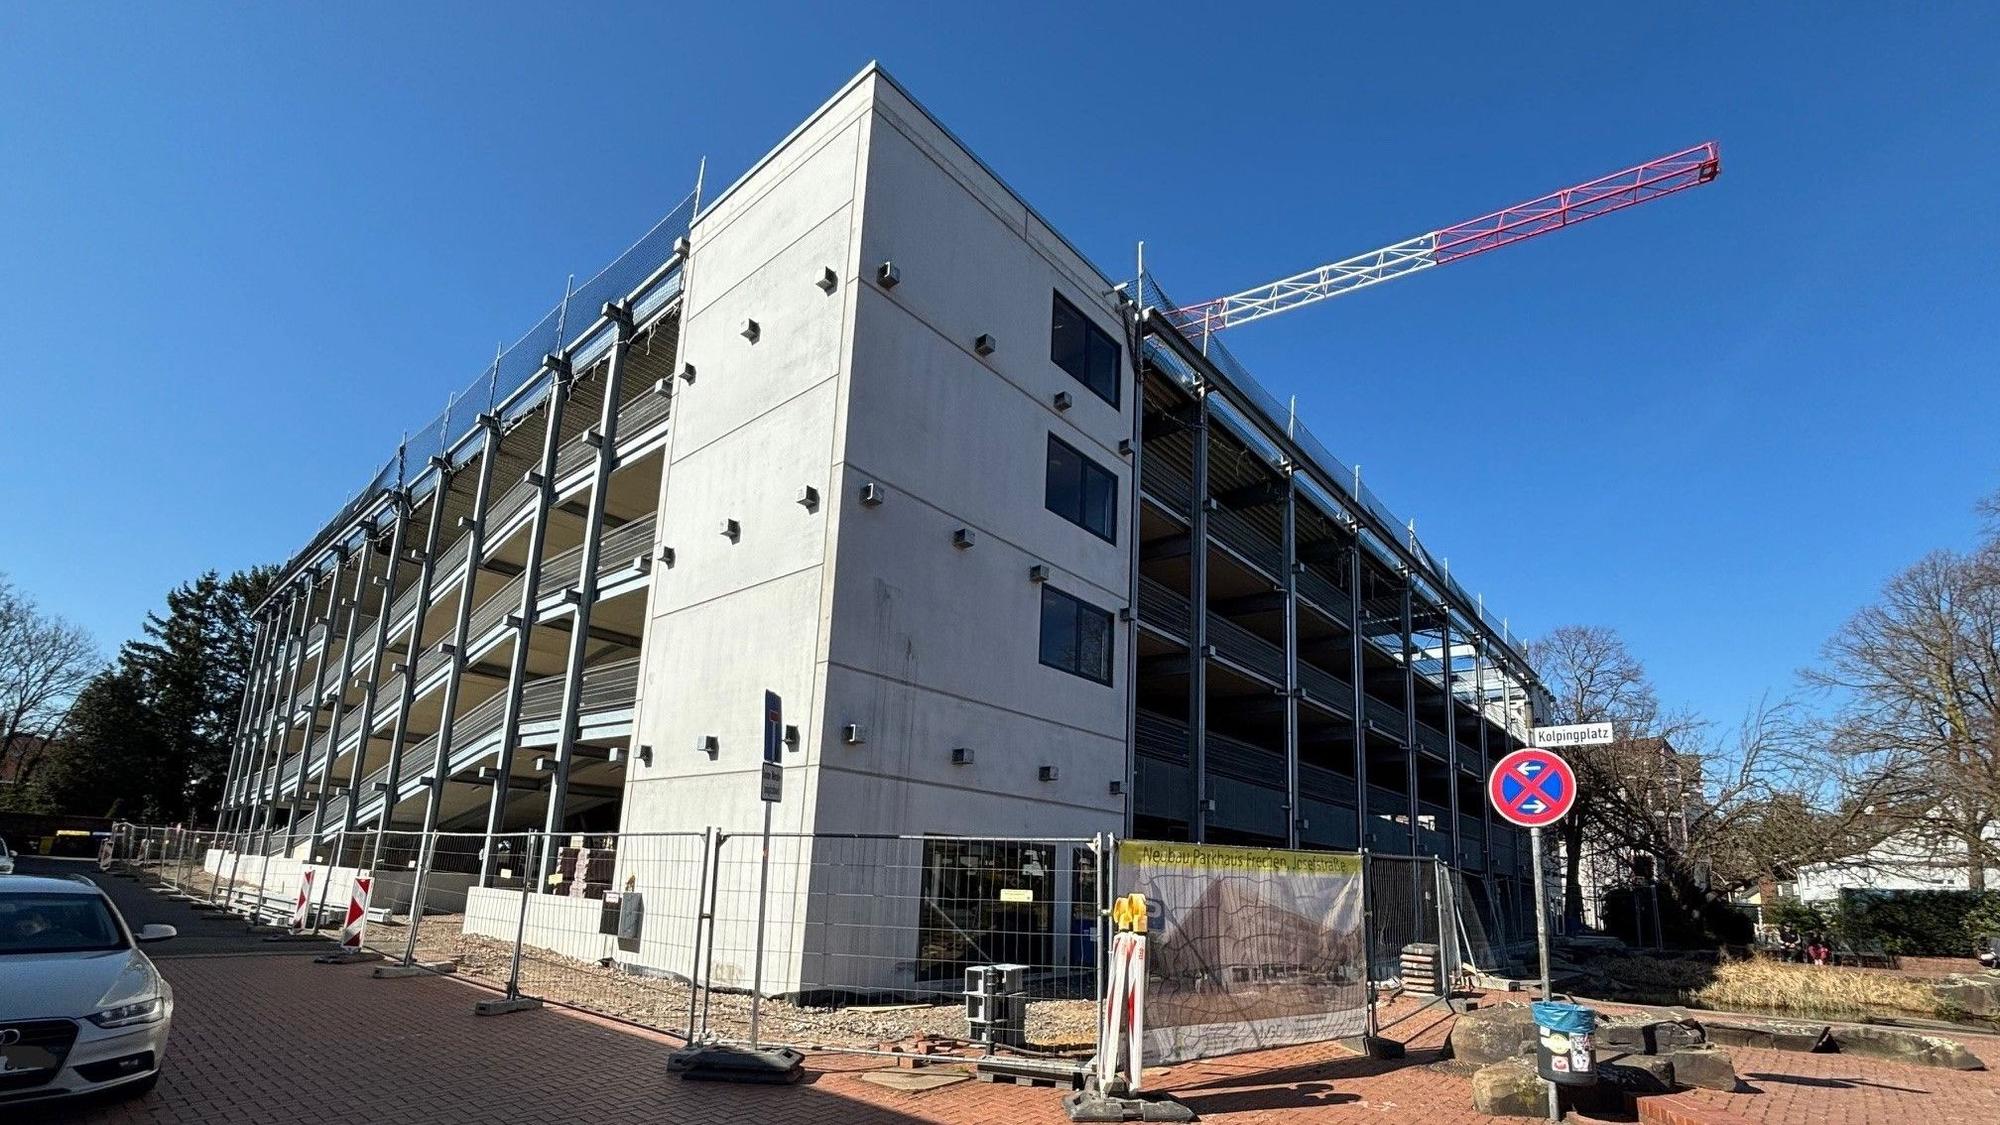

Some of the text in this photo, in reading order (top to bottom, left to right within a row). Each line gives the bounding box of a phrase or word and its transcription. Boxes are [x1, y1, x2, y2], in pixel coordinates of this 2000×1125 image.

[1538, 728, 1609, 743] Kolpingplatz
[1143, 846, 1346, 872] Neubau Parkhaus Frechen, Josefstraße
